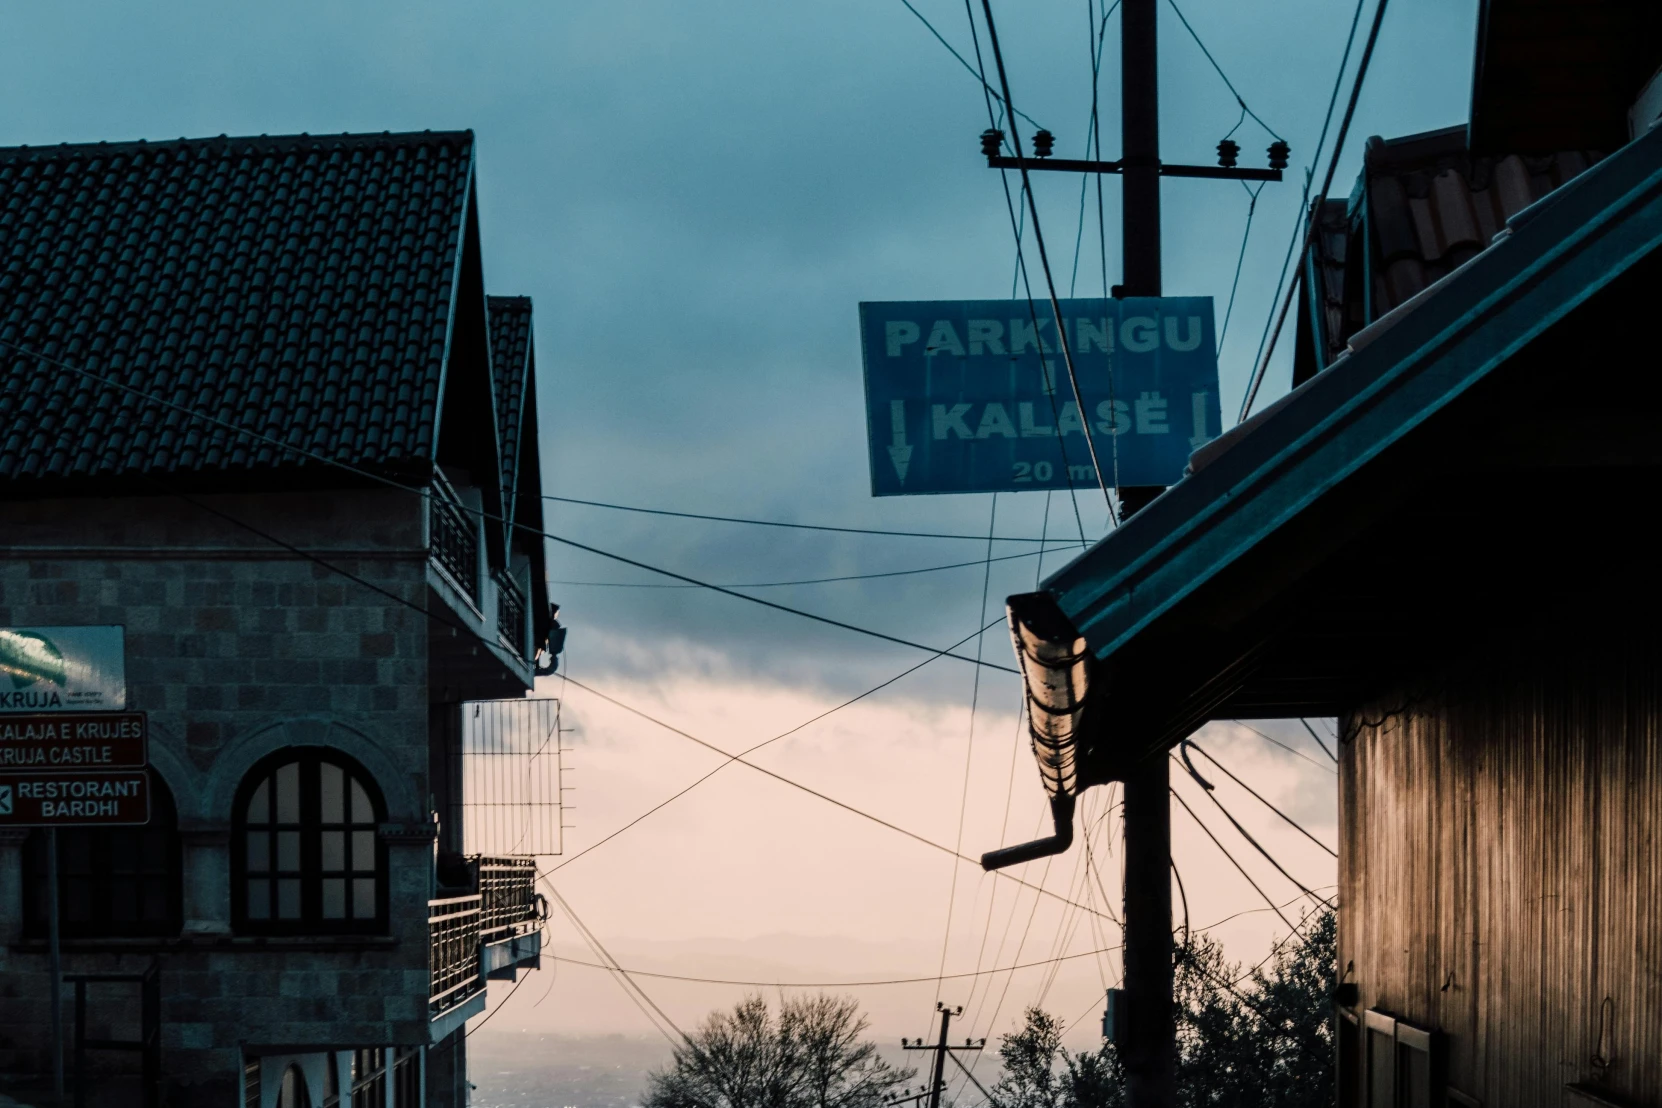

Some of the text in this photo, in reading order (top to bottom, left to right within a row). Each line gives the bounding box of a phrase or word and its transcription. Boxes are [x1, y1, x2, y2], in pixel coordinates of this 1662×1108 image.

[884, 315, 1203, 357] PARKINGU
[931, 391, 1171, 440] KALASË
[1012, 461, 1096, 482] 20 m
[0, 691, 62, 709] KRUJA
[0, 718, 141, 740] ALAJA E KRUJËS
[49, 745, 113, 764] CASTLE
[18, 780, 142, 799] RESTORANT
[42, 800, 119, 818] BARDHI
